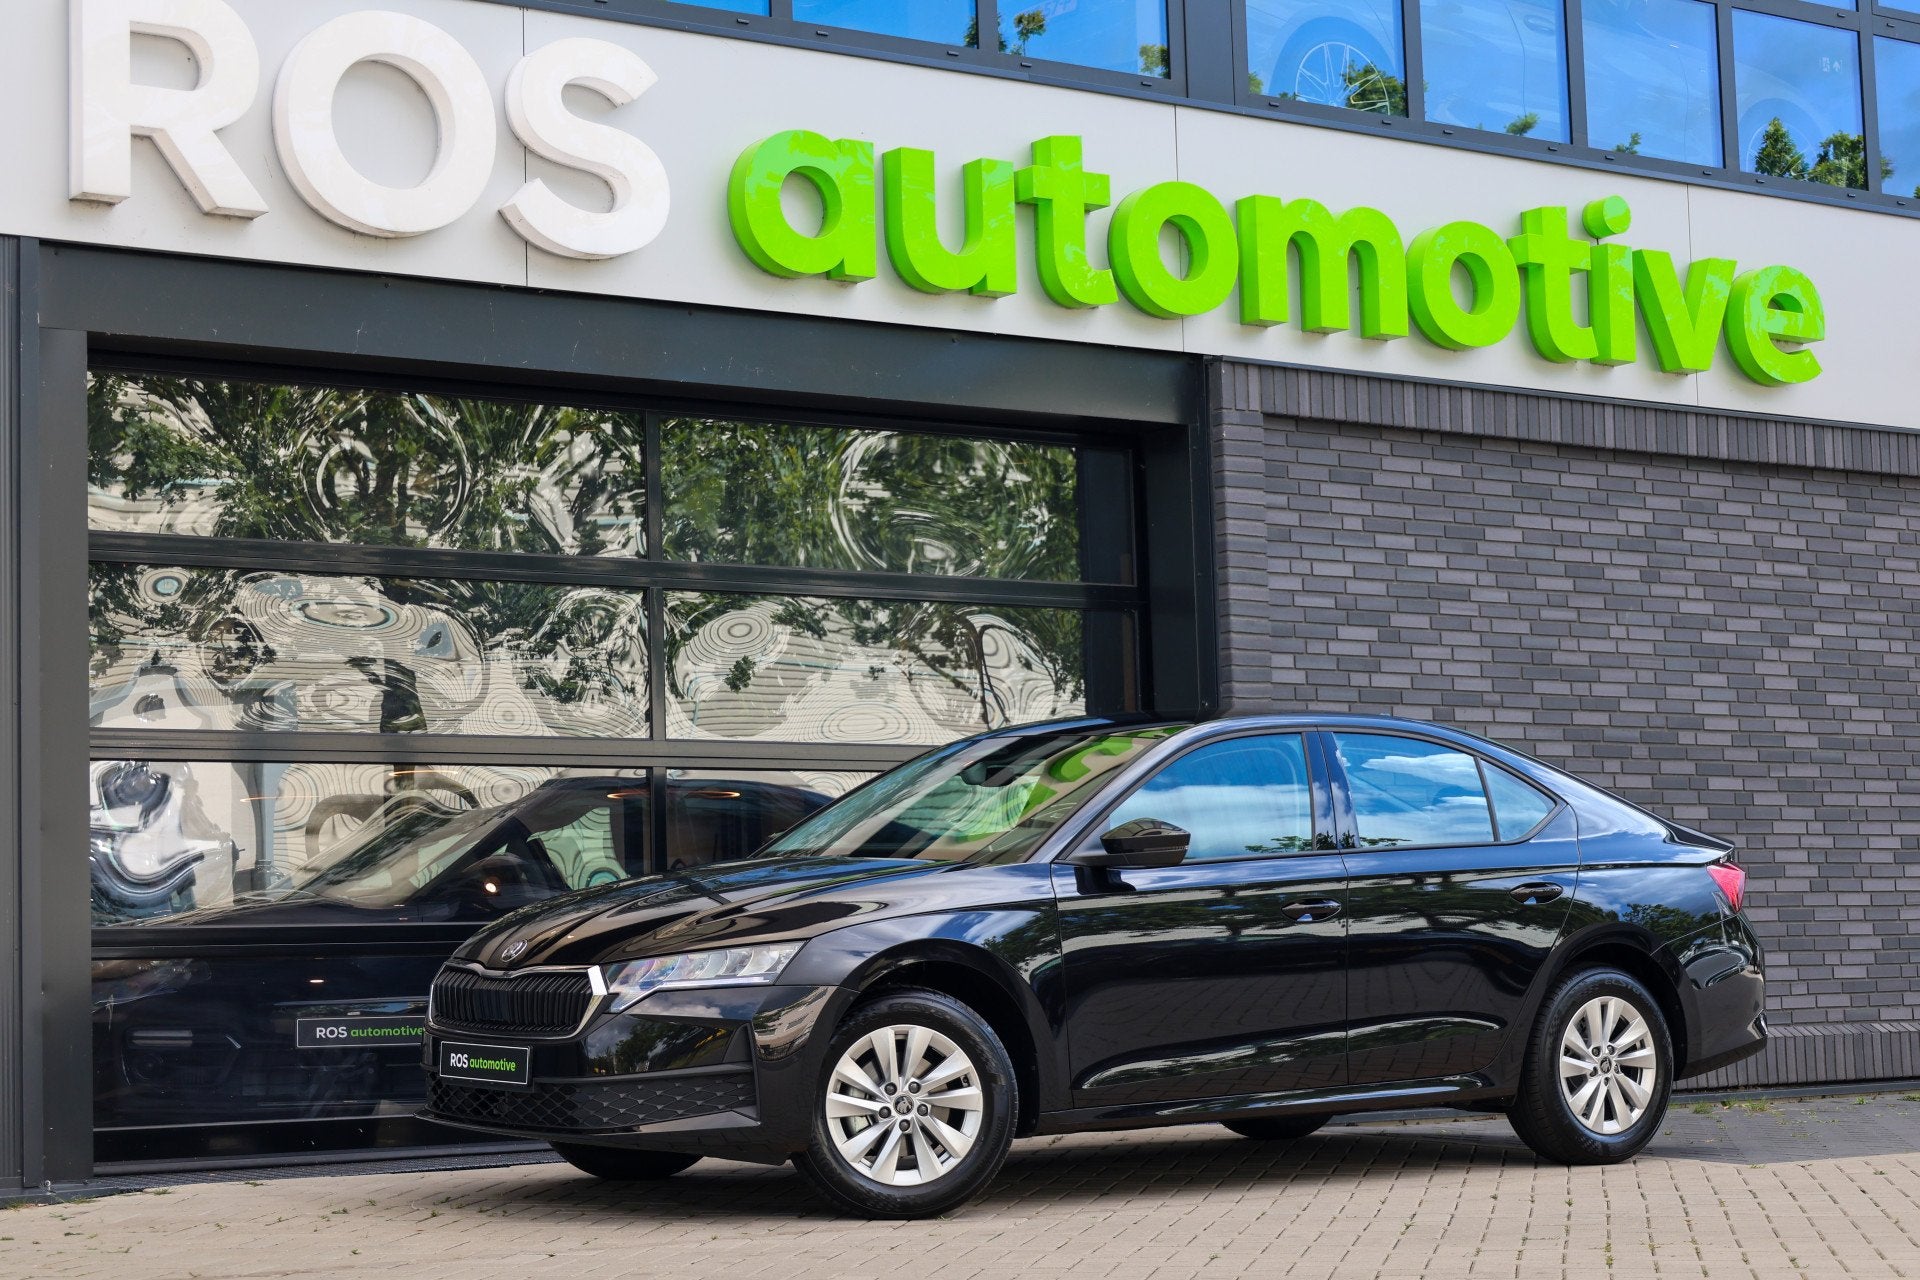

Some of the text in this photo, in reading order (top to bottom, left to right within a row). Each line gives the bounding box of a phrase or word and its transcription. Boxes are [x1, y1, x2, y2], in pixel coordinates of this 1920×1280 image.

[69, 0, 1826, 388] ROS automotive
[315, 1025, 425, 1039] ROS automotive
[450, 1053, 517, 1072] ROS automotive
